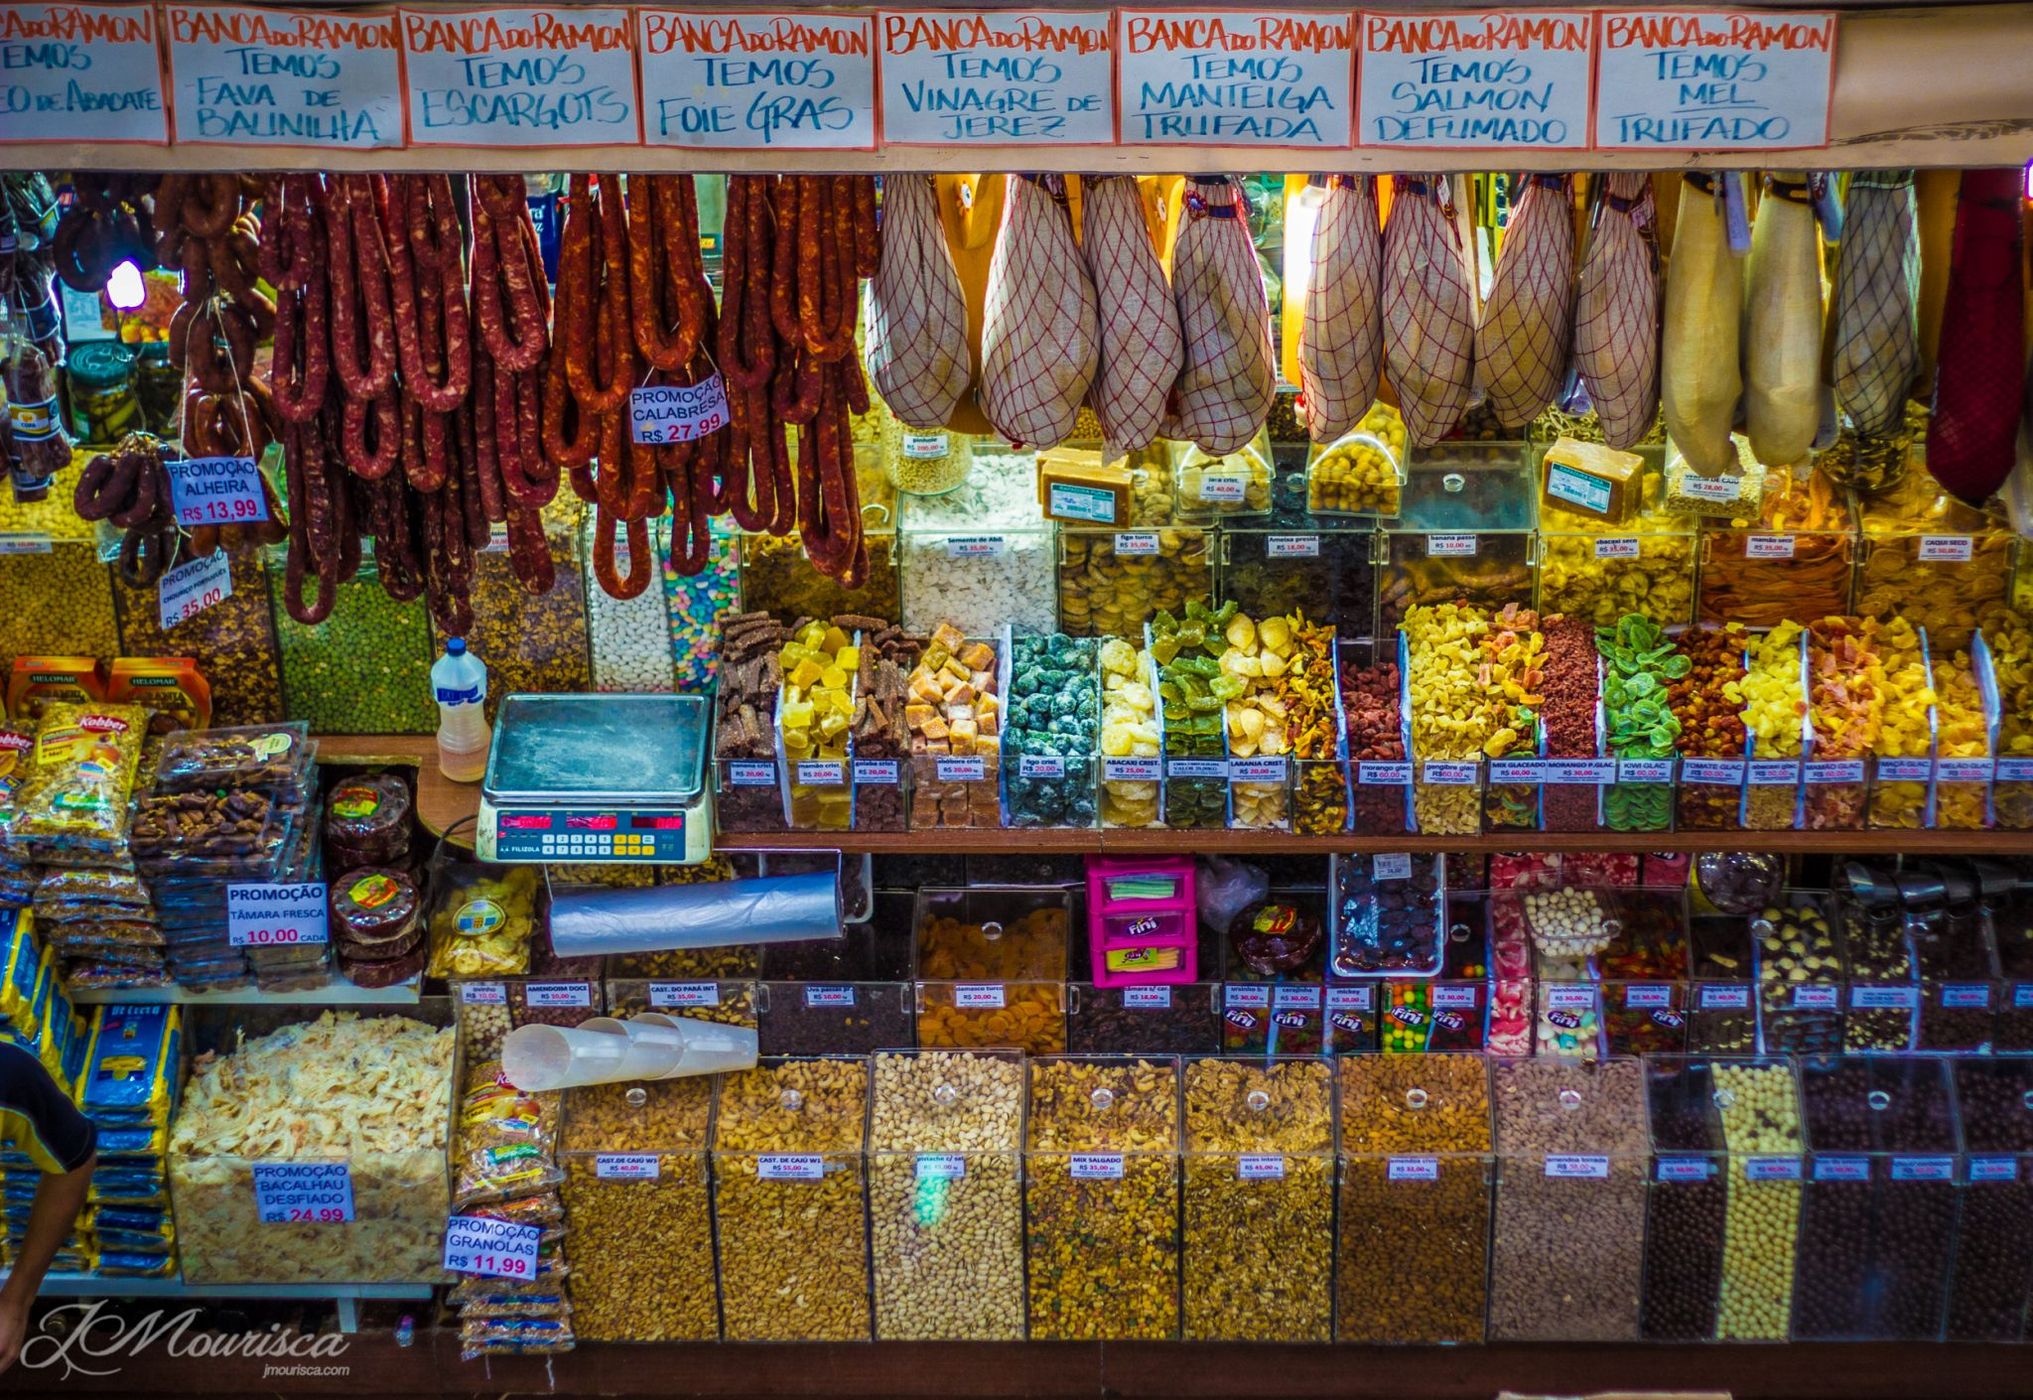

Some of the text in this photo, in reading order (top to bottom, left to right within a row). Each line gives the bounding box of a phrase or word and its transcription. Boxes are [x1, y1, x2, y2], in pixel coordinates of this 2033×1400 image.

[44, 7, 151, 43] RAMON
[171, 10, 270, 44] BANCA
[289, 15, 398, 49] RAMON
[406, 15, 500, 54] BANCA
[533, 13, 631, 52] RAMON
[645, 15, 746, 55] BANCA
[769, 17, 867, 57] RAMON
[885, 15, 994, 55] BANCA
[1016, 16, 1114, 55] RAMON
[1128, 17, 1227, 53] BANCA
[1253, 17, 1354, 54] RAMON
[1368, 17, 1462, 54] BANCA
[1480, 14, 1588, 53] RAMON
[1607, 16, 1701, 49] BANCA
[1726, 15, 1832, 52] RAMON
[0, 41, 92, 70] EMOS
[224, 47, 341, 79] TEMOS
[933, 52, 1062, 84] TEMOS
[1181, 53, 1303, 82] TEMOS
[1411, 55, 1531, 85] TEMOS
[1645, 50, 1767, 82] TEMOS
[455, 54, 586, 88] TEMOS
[694, 58, 835, 88] TEMOS
[66, 78, 161, 113] ABACATE
[196, 76, 341, 107] FAVA DE
[902, 80, 1103, 113] VINAGRE DE
[1140, 82, 1335, 113] MANTEIGA
[1391, 81, 1554, 113] SALMON
[1679, 83, 1756, 105] MEL
[423, 86, 629, 129] ESCARGOTS
[657, 91, 854, 143] FOIE GRAS
[197, 108, 382, 141] BAUNILHA
[939, 113, 1066, 139] JEREZ
[1132, 111, 1323, 142] TRUFADA
[1373, 115, 1567, 144] DEFUMADO
[1610, 113, 1790, 142] TRUFADO
[632, 375, 721, 404] PROMOÇÃO
[633, 392, 725, 421] CALABRESA
[642, 430, 663, 442] R$
[170, 461, 255, 478] PROMOÇÃO
[185, 481, 250, 496] ALHEIRA
[182, 499, 258, 521] R$ 13,99
[162, 550, 225, 589] PROMOÇÃO
[166, 612, 180, 627] R$
[79, 716, 127, 732] Kobber
[230, 886, 323, 902] PROMOÇÃO
[231, 909, 325, 919] TÂMARA FRESCA
[1128, 917, 1157, 935] Fini
[247, 929, 298, 945] 10,00
[300, 934, 326, 942] CADA
[1226, 1009, 1256, 1027] Fini
[1275, 1012, 1306, 1026] Fini
[1331, 1013, 1361, 1029] Fini
[1392, 1007, 1423, 1025] Fini
[1433, 1009, 1463, 1028] Fini
[1550, 1012, 1578, 1028] Fini
[1653, 1010, 1681, 1026] Fini
[254, 1164, 347, 1178] PROMOÇÃO
[260, 1181, 344, 1191] BACALHAU
[265, 1194, 344, 1205] DESFIADO
[266, 1212, 286, 1222] R$
[449, 1219, 539, 1242] PROMOÇÃO
[450, 1234, 535, 1256] GRANOLAS
[449, 1255, 526, 1275] R$ 11,99
